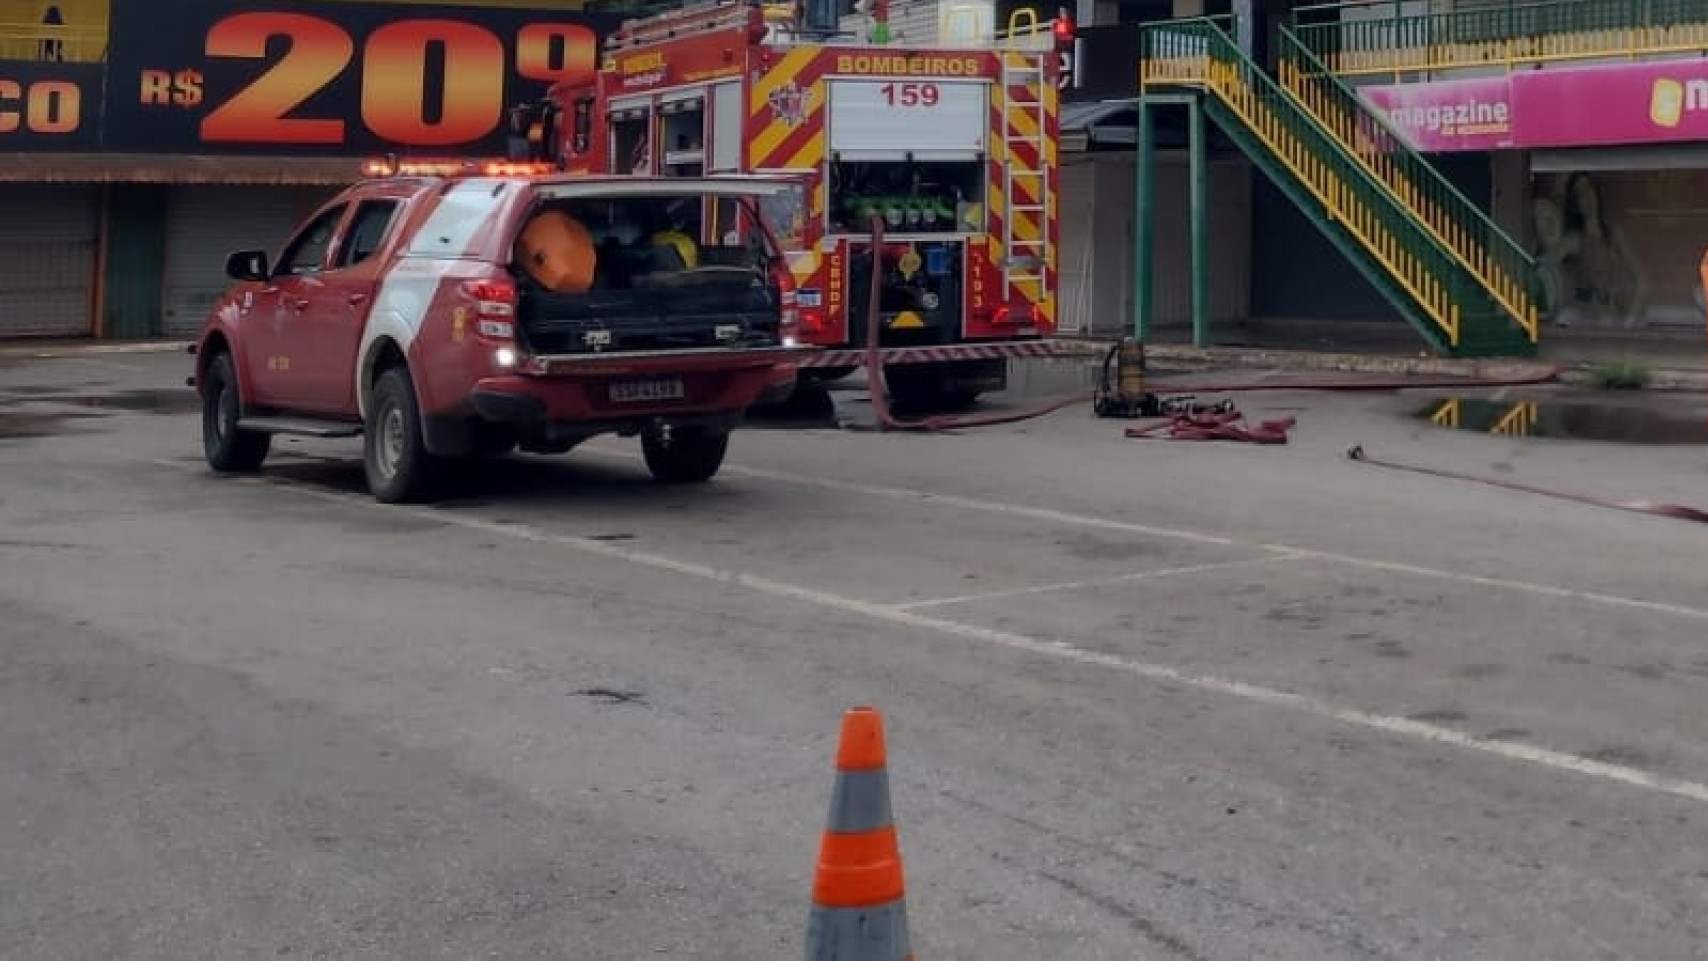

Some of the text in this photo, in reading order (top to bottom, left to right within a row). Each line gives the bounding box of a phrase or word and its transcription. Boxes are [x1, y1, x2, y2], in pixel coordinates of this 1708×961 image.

[836, 55, 980, 76] BOMBEIROS
[140, 67, 204, 108] R$
[881, 82, 940, 108] 159
[1391, 97, 1508, 131] magazine
